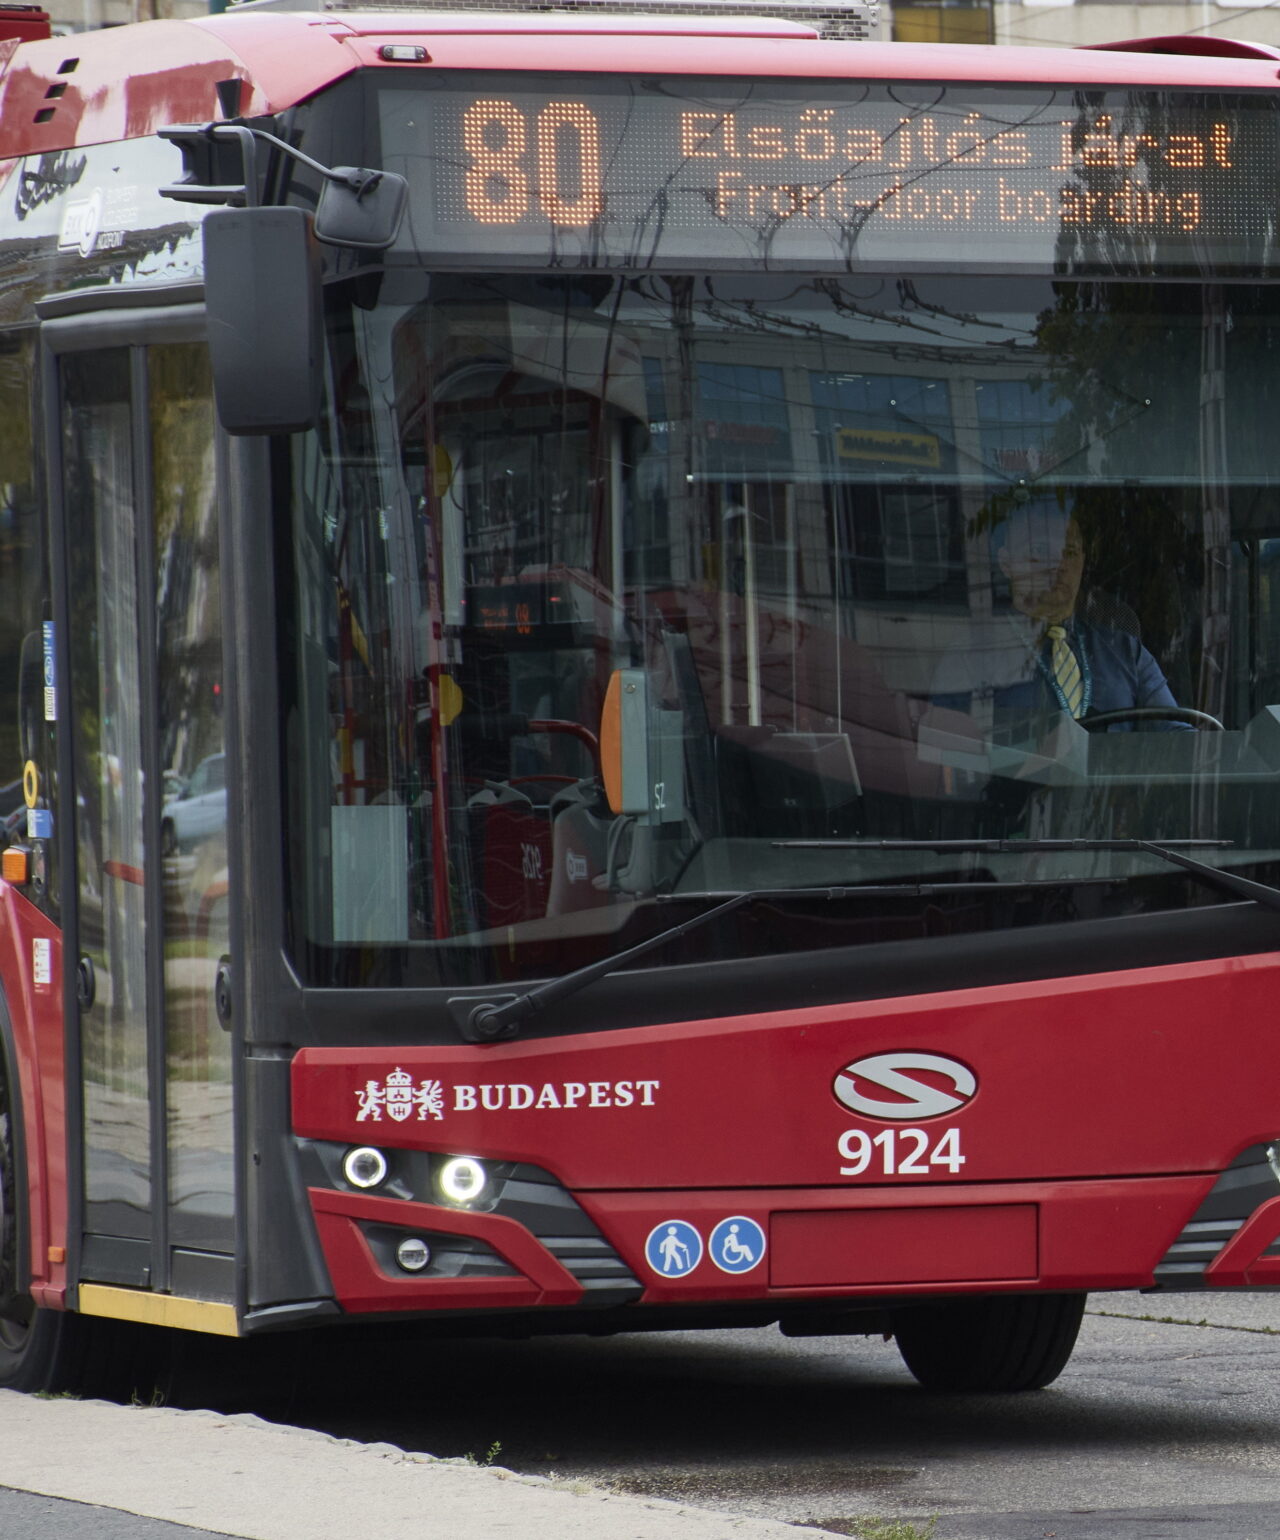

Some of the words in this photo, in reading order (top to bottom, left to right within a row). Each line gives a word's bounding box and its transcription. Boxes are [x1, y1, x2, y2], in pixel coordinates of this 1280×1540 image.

[463, 100, 601, 226] 80
[682, 109, 1032, 168] Elsőajtós
[1050, 114, 1232, 171] járat
[718, 171, 982, 222] Front-door
[999, 176, 1201, 231] boarding
[452, 1079, 661, 1112] BUDAPEST
[836, 1127, 967, 1177] 9124
